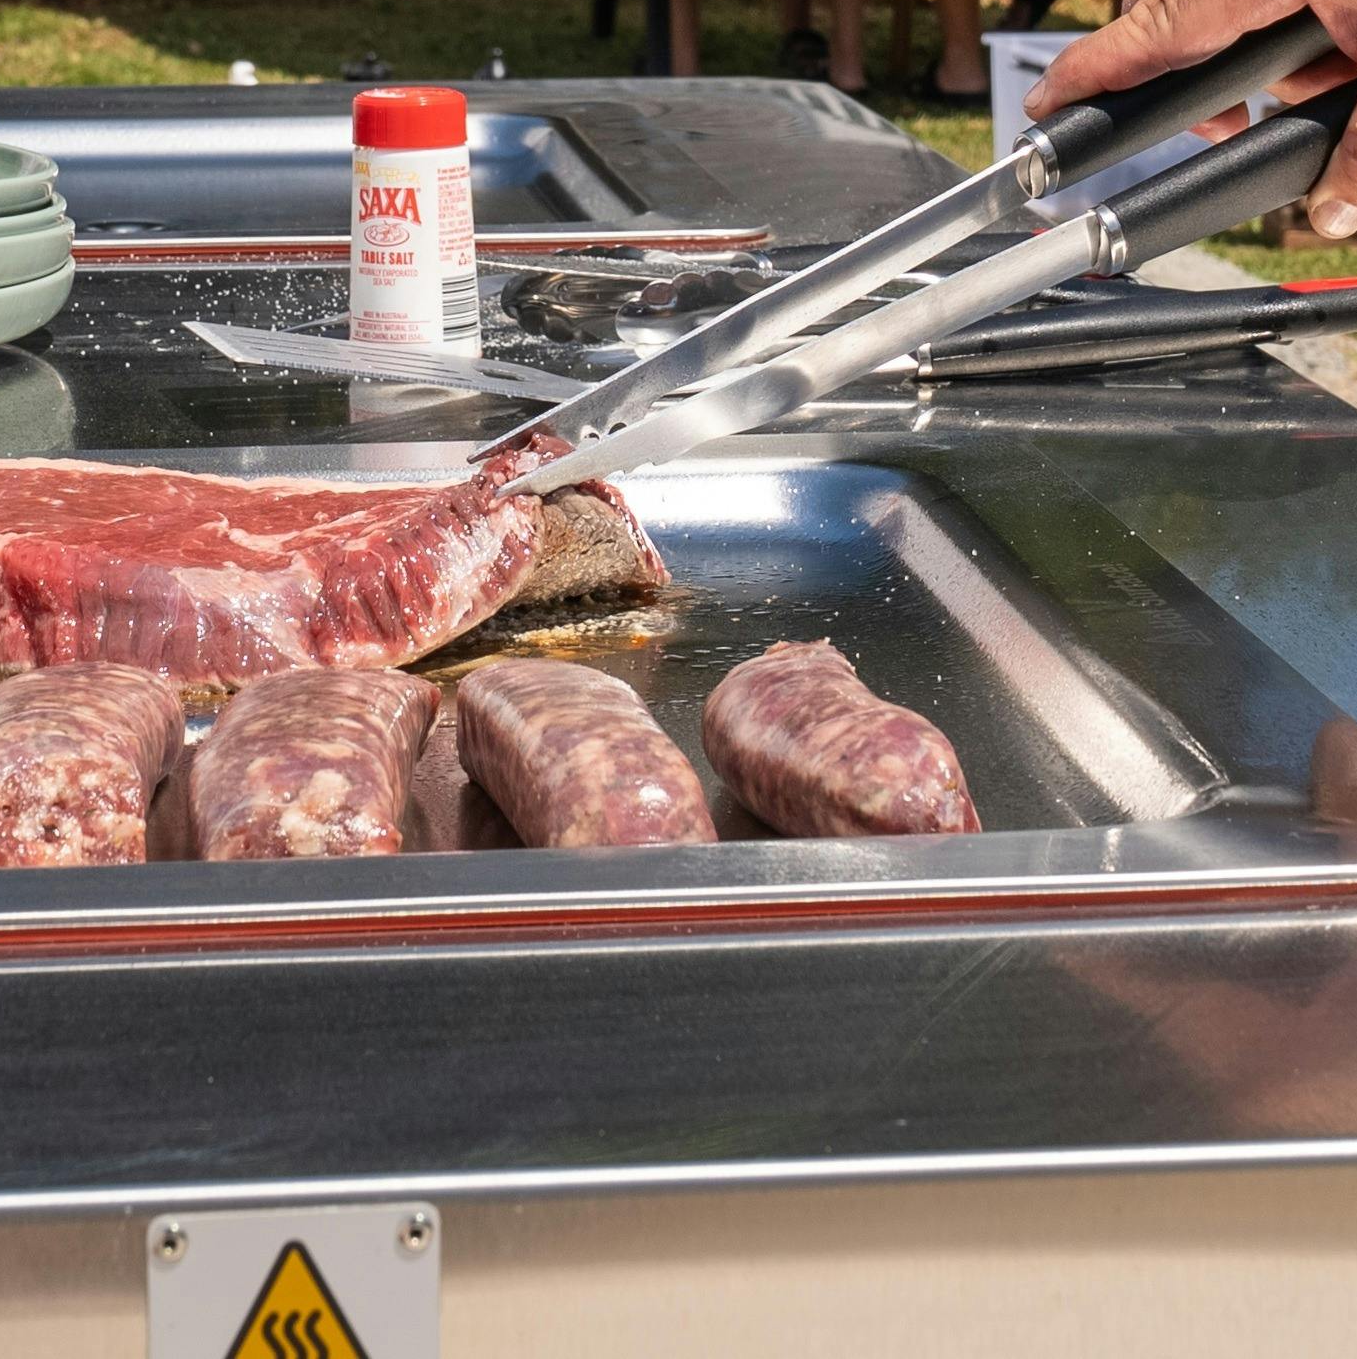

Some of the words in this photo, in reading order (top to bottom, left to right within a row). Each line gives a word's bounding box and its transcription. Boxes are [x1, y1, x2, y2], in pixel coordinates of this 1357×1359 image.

[358, 187, 421, 224] SAXA
[361, 250, 385, 264] TABLE
[389, 252, 414, 265] SALT
